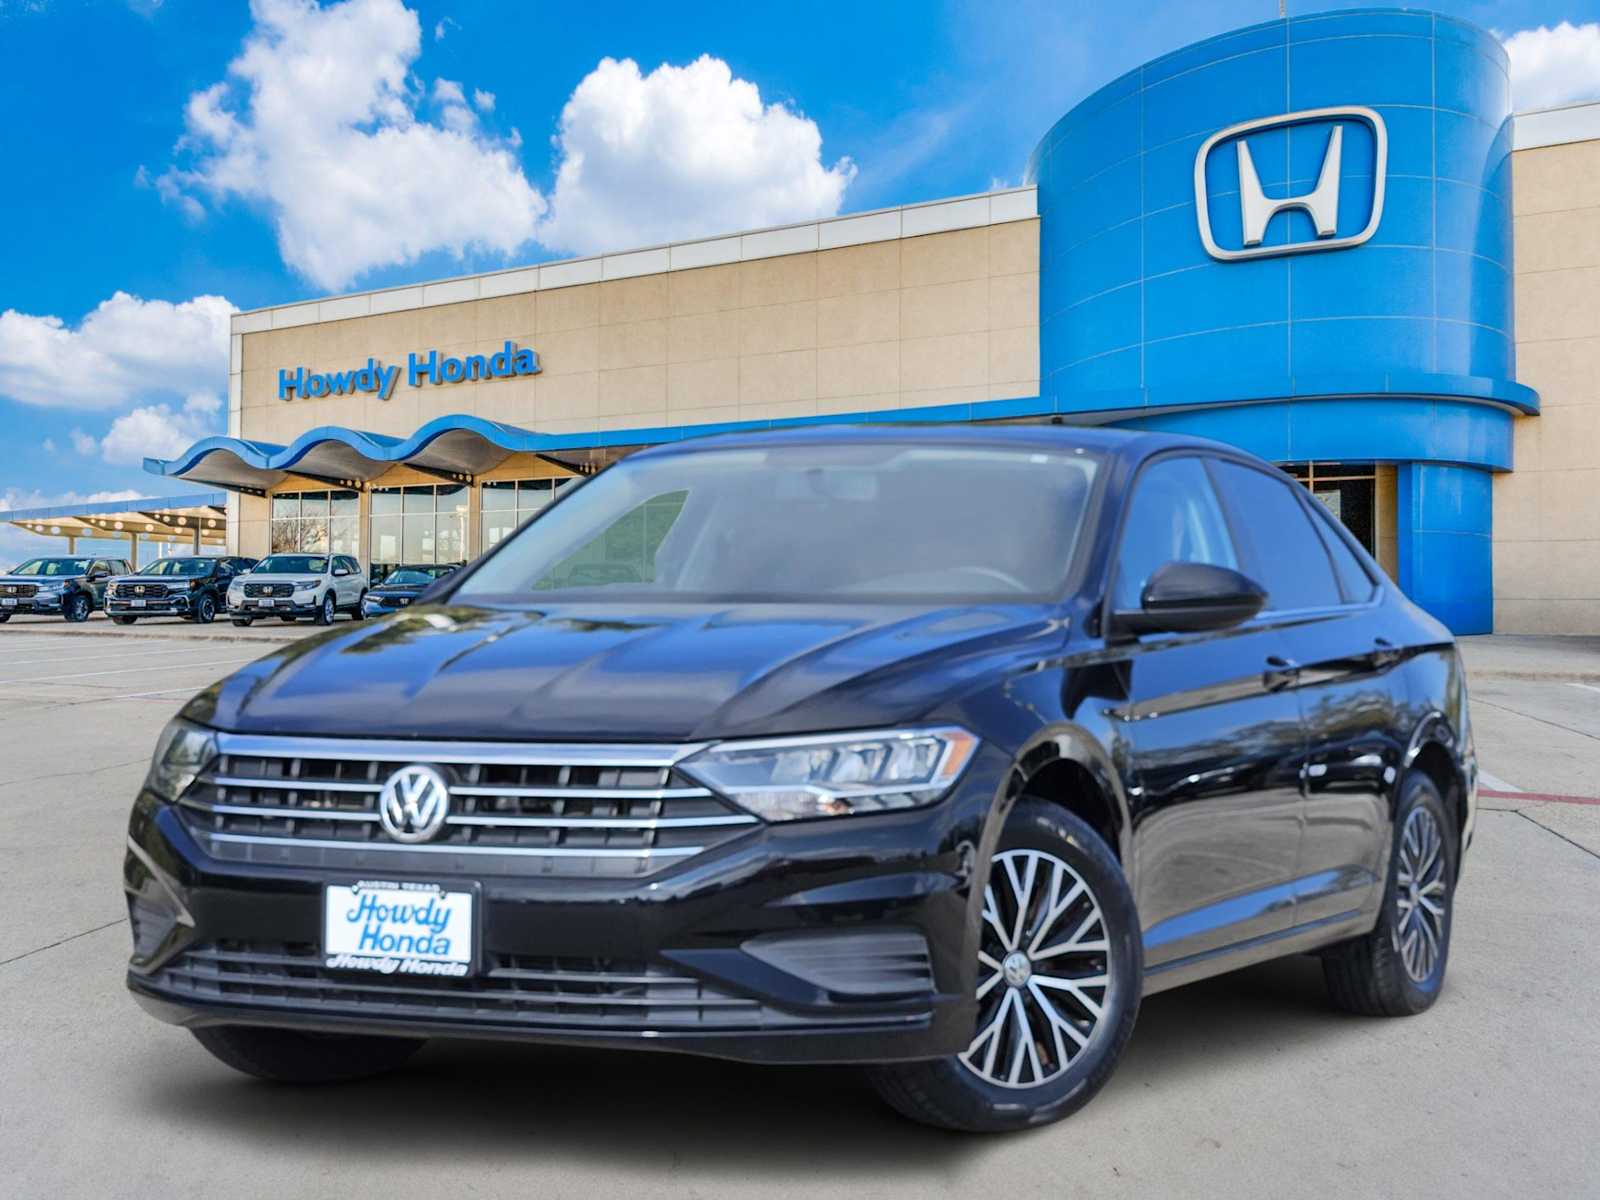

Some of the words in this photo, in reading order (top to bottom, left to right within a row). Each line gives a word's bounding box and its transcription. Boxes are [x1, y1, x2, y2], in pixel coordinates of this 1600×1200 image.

[1236, 125, 1344, 247] H
[278, 358, 401, 400] Howdy
[408, 341, 542, 388] Honda
[380, 765, 447, 842] VW
[346, 894, 451, 934] Howdy
[358, 923, 451, 955] Honda
[326, 953, 400, 974] Howdy
[400, 958, 468, 976] Honda
